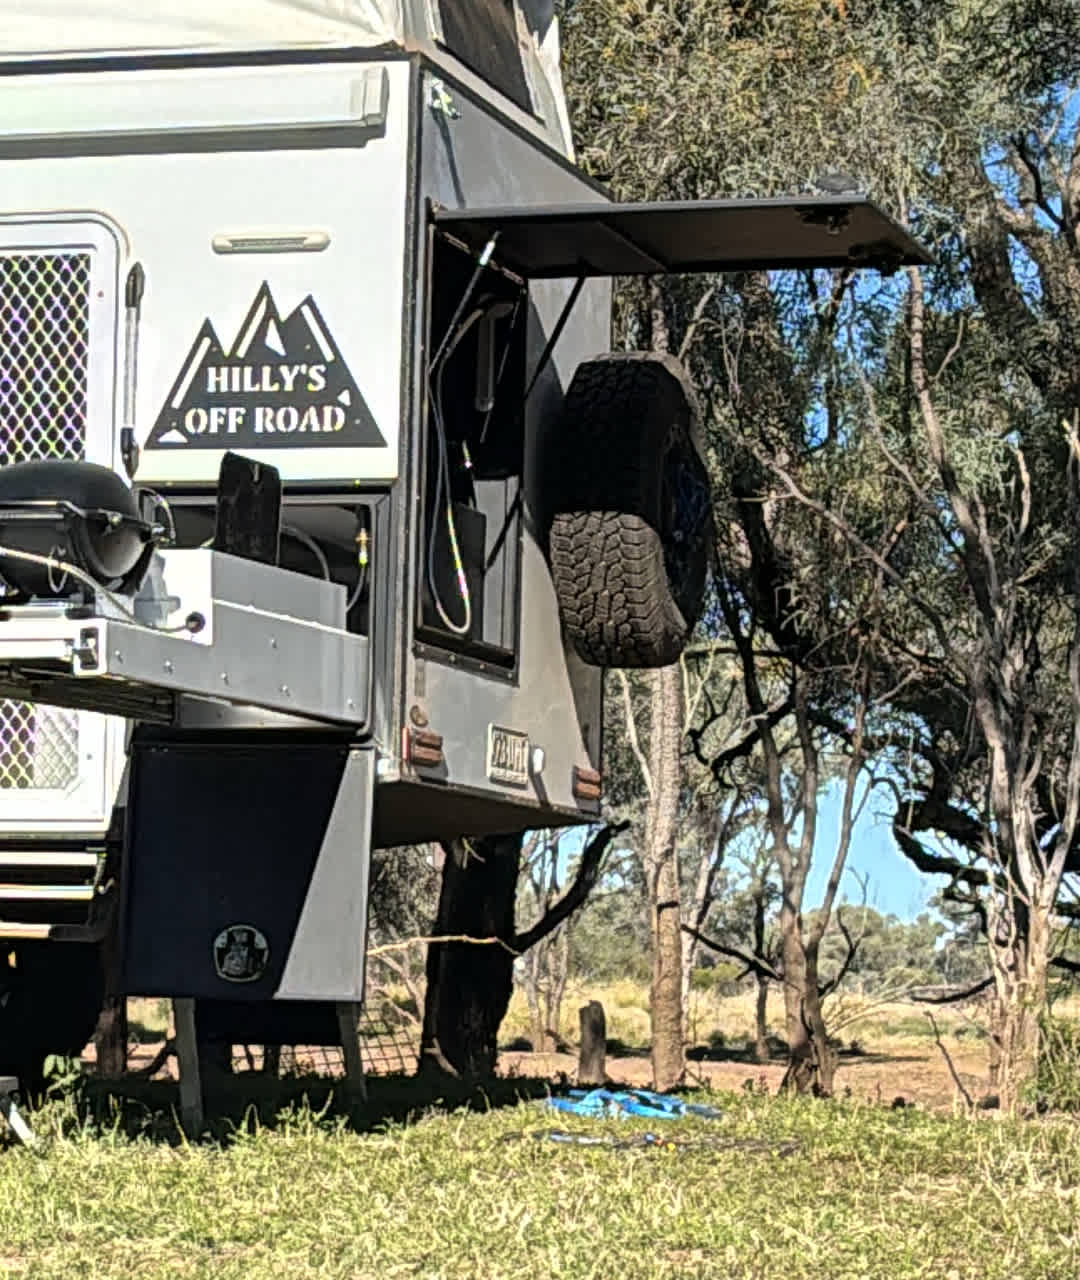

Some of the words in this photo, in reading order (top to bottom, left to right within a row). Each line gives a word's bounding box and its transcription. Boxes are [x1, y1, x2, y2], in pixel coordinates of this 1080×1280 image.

[207, 364, 327, 393] HILLY'S
[184, 407, 246, 434] OFF
[254, 405, 346, 433] ROAD
